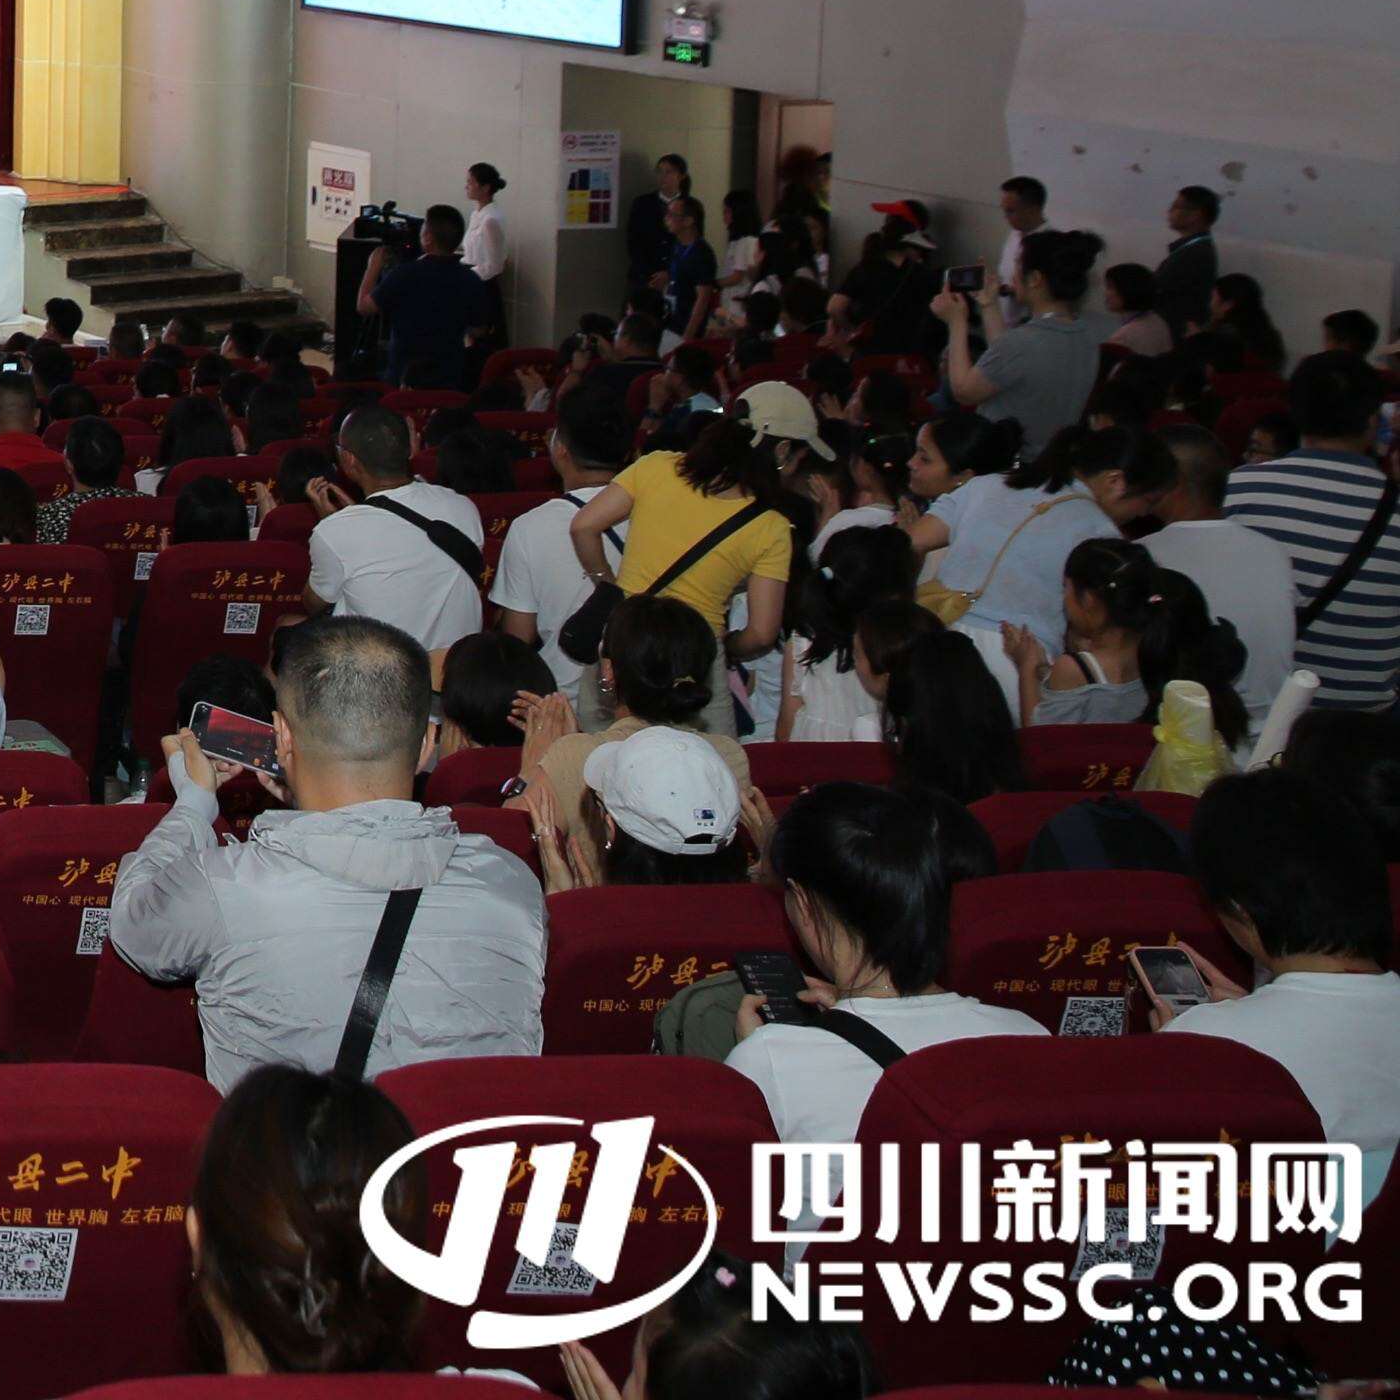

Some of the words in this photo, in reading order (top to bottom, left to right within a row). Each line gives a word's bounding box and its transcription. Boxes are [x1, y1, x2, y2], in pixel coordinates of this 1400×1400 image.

[45, 1208, 109, 1226] 世界胸
[120, 1204, 185, 1225] 左右脑
